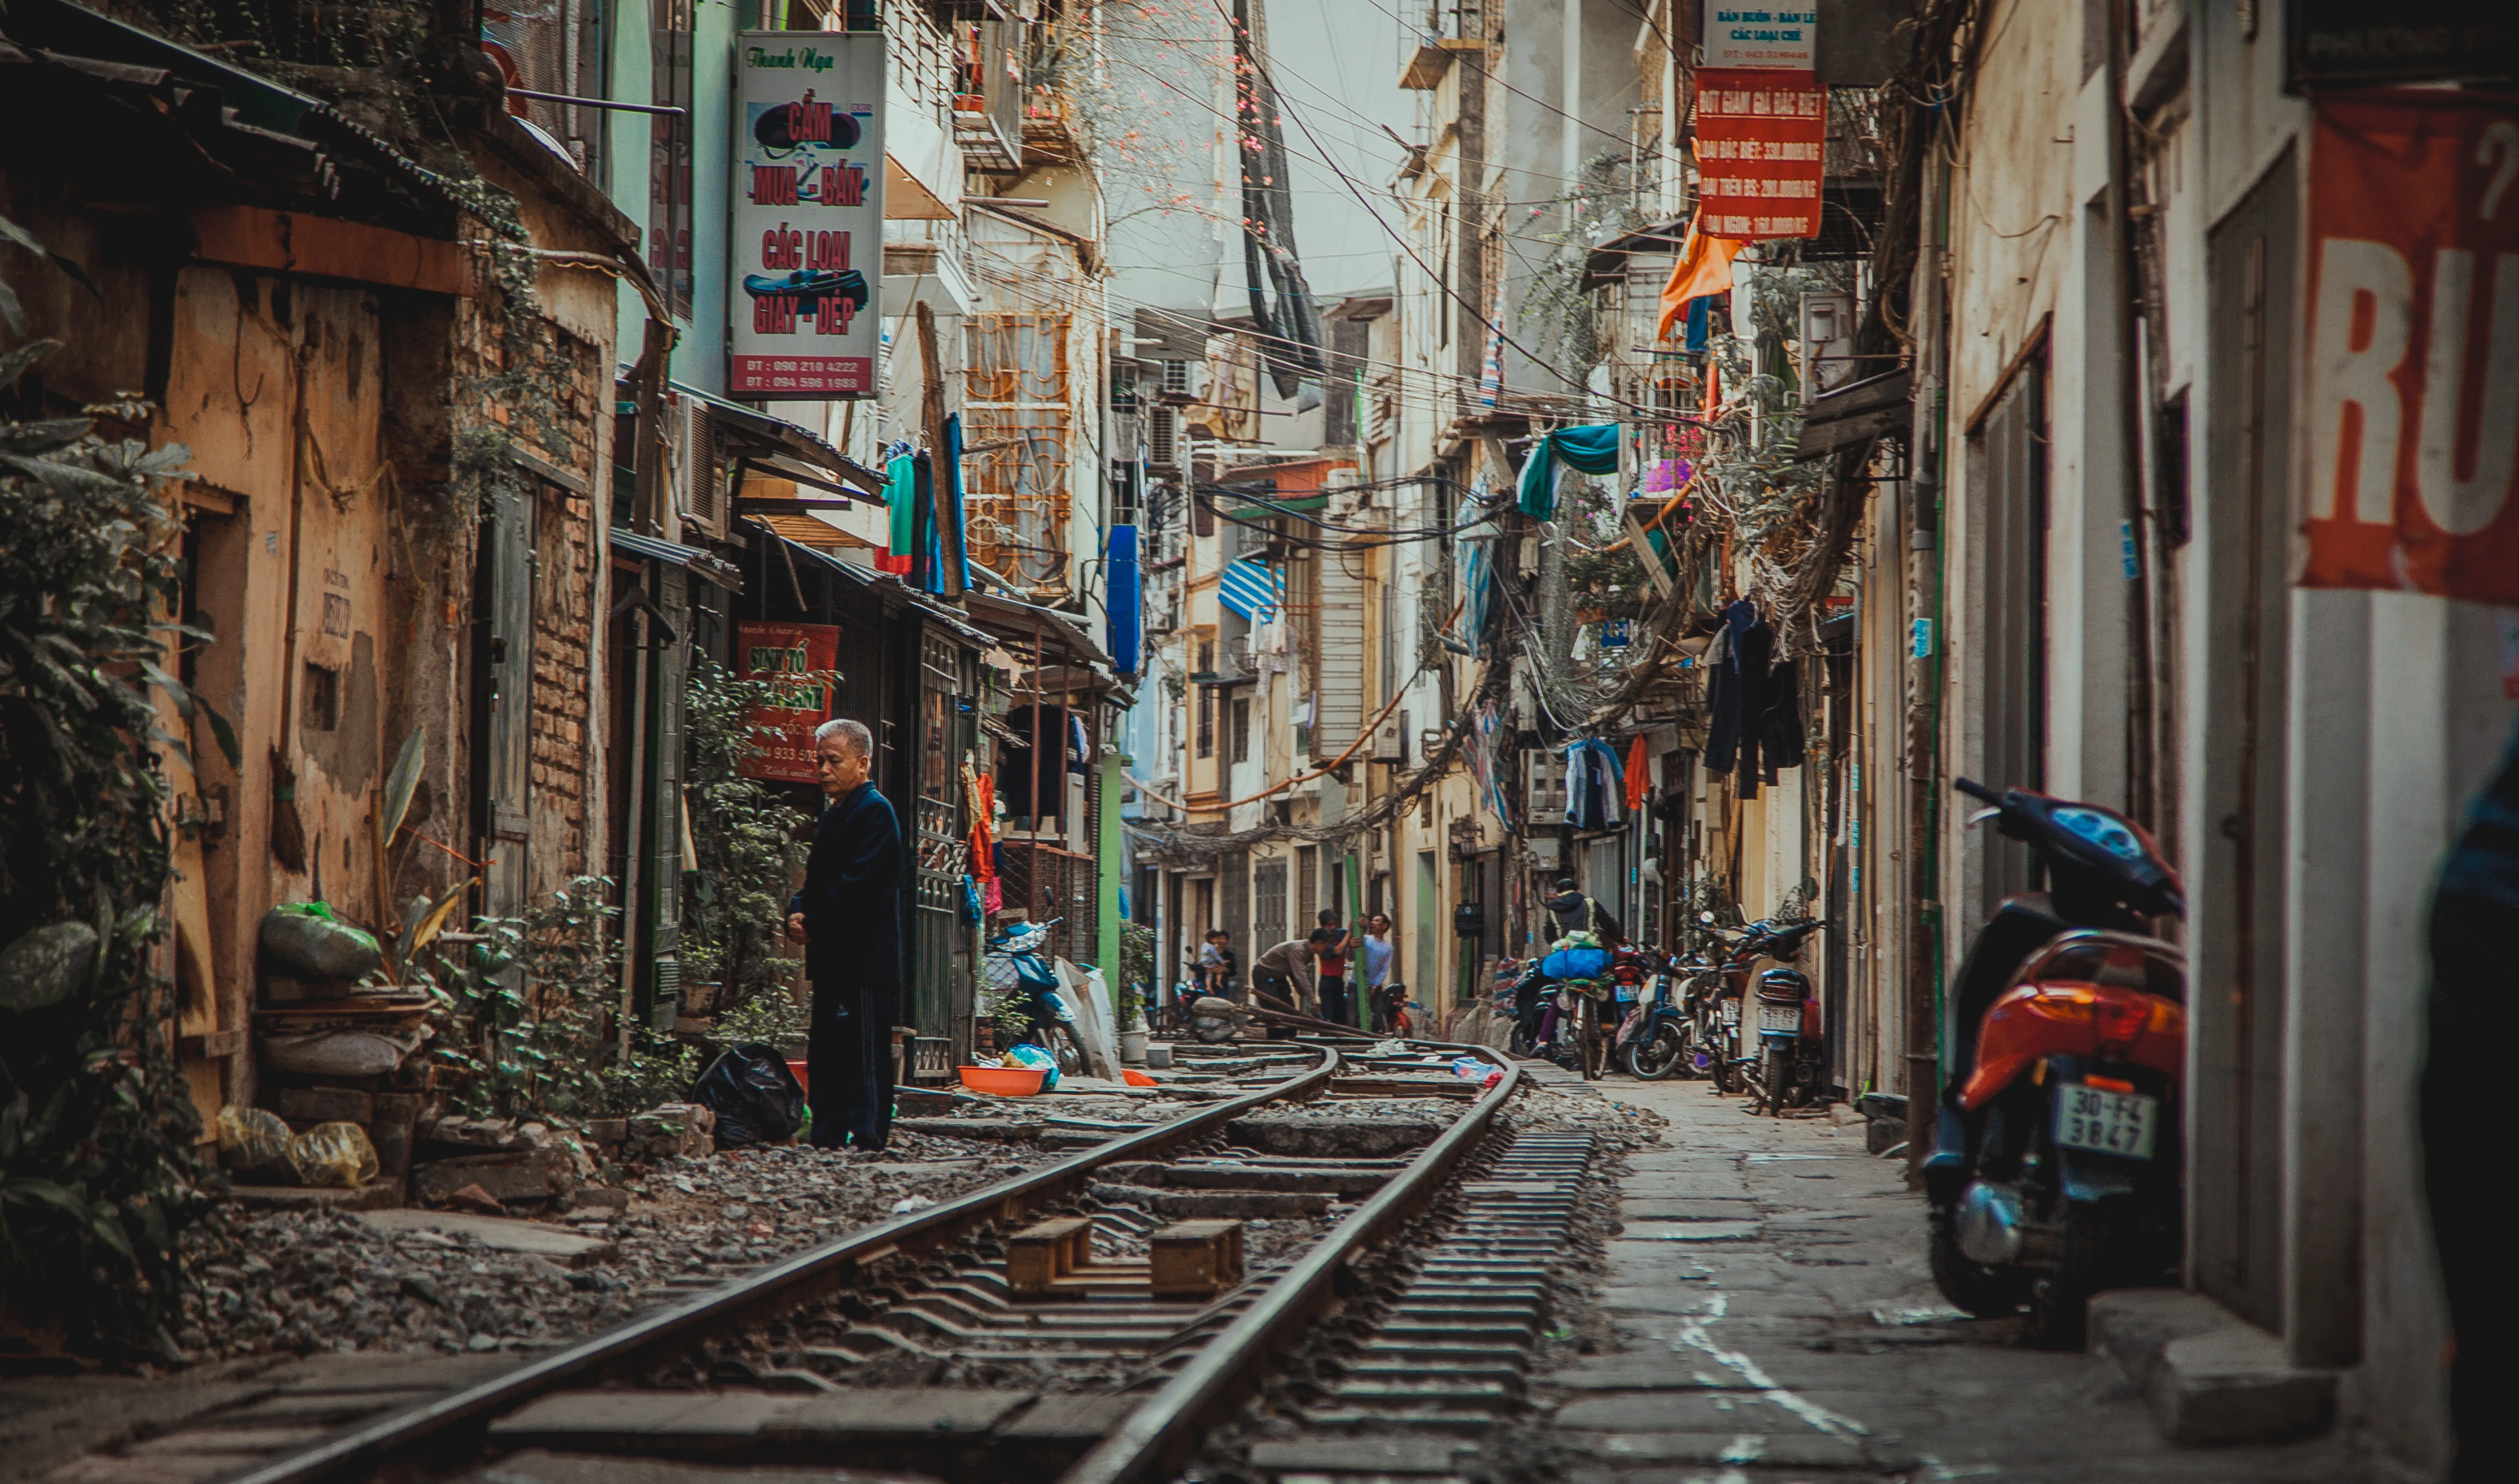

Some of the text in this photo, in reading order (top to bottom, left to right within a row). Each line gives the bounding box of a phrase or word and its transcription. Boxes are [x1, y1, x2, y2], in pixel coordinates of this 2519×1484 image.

[746, 46, 834, 74] Thanh Nga
[753, 165, 799, 206] MUA
[821, 158, 864, 206] BÁN
[762, 222, 851, 279] CÁC LOẠI
[816, 288, 855, 335] DÉP
